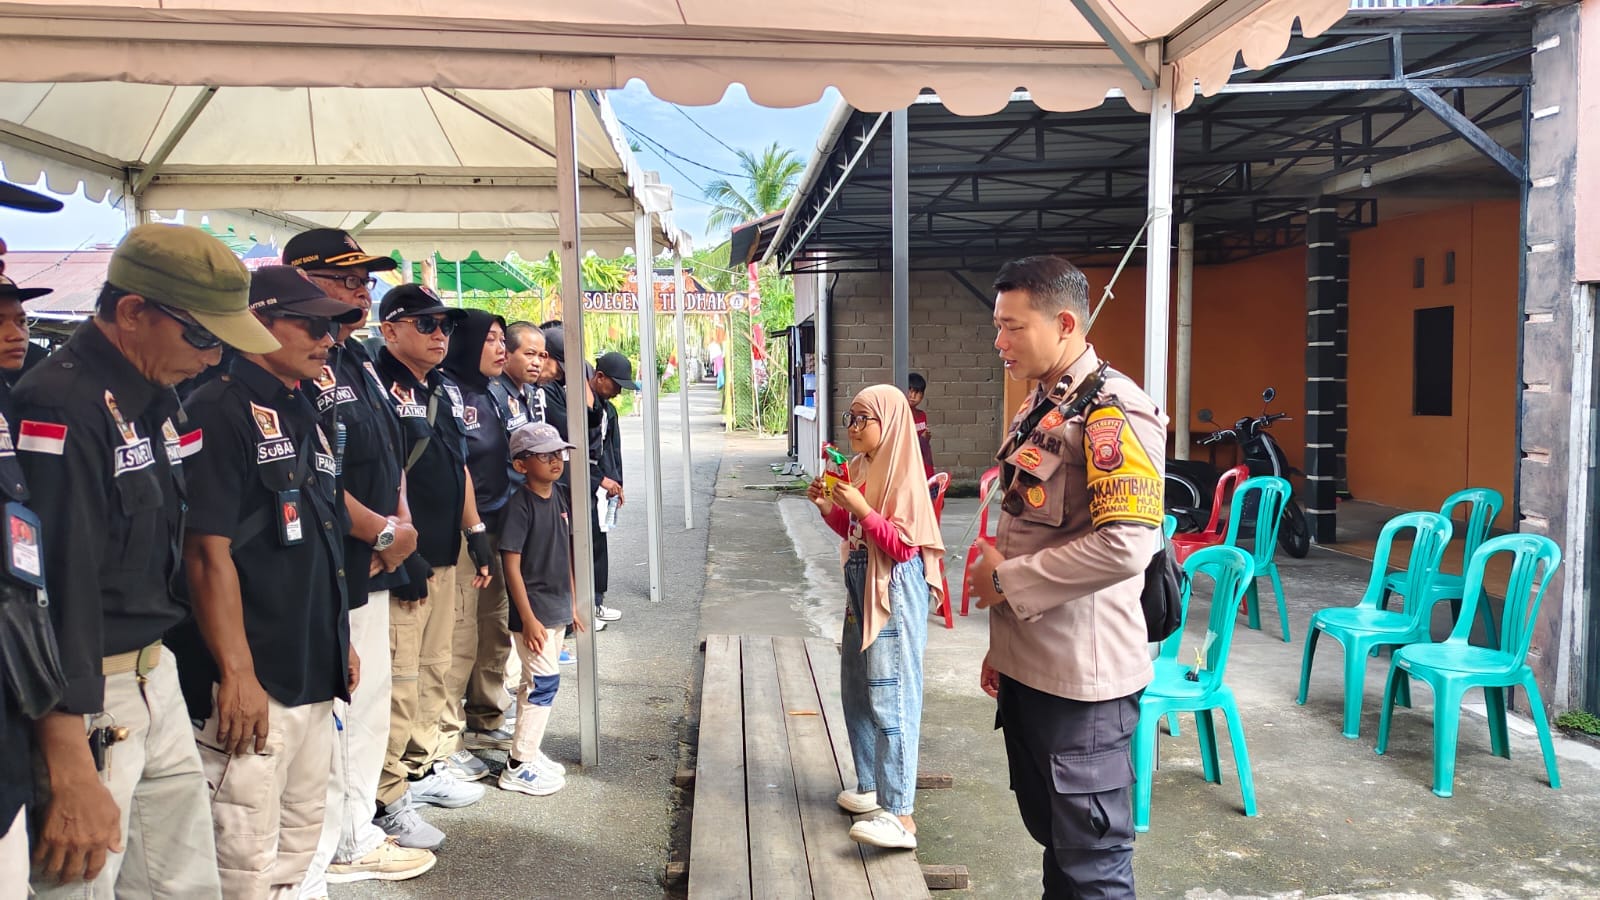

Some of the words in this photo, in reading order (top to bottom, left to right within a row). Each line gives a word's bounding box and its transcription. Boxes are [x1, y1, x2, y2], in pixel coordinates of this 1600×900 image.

[583, 291, 639, 310] SOEGEN
[660, 291, 726, 310] TIDHAK
[1028, 429, 1062, 455] OLRI
